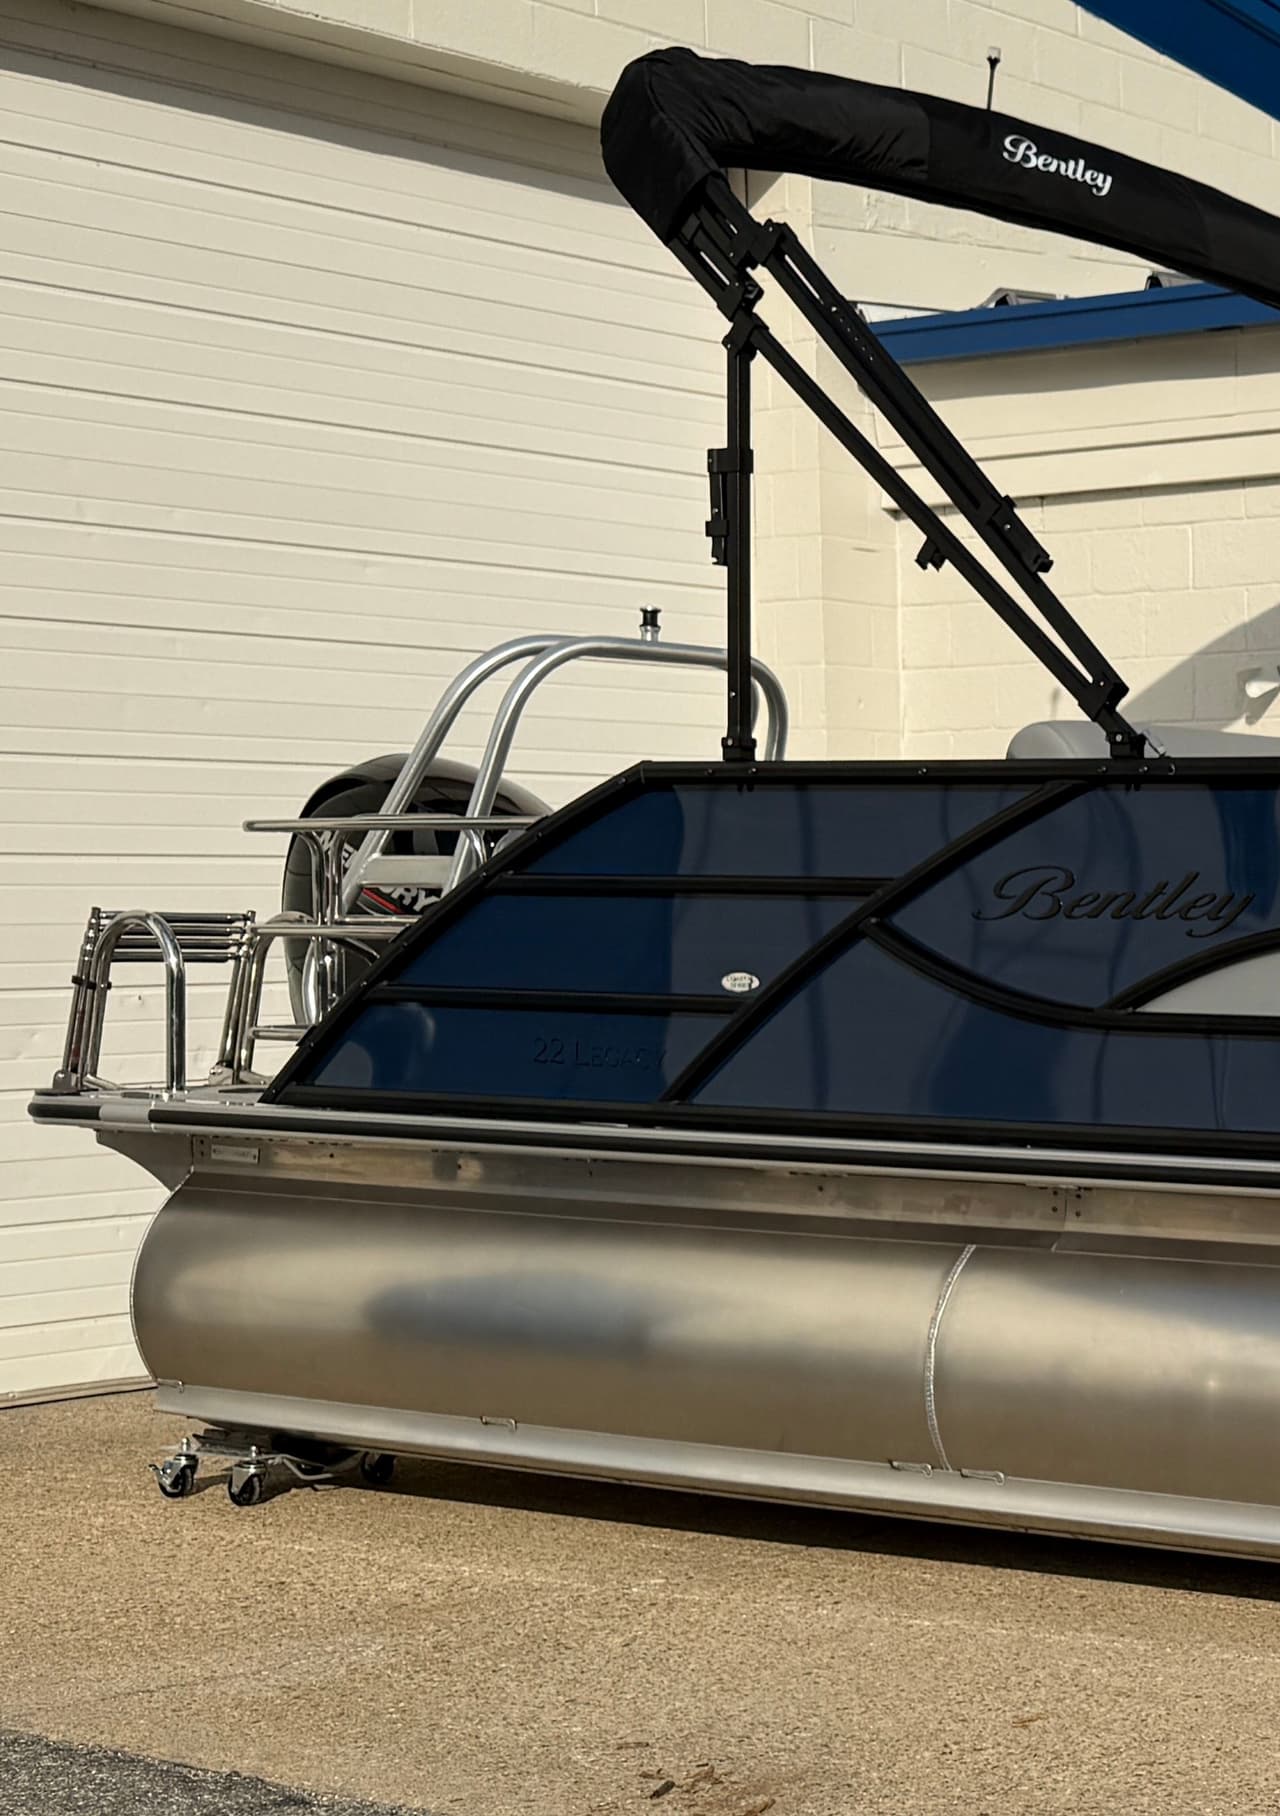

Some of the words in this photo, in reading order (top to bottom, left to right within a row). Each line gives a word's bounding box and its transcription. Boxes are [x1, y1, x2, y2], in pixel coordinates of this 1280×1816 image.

[1002, 134, 1113, 197] Bentley
[971, 865, 1256, 938] Bentley
[533, 1037, 565, 1065] 22
